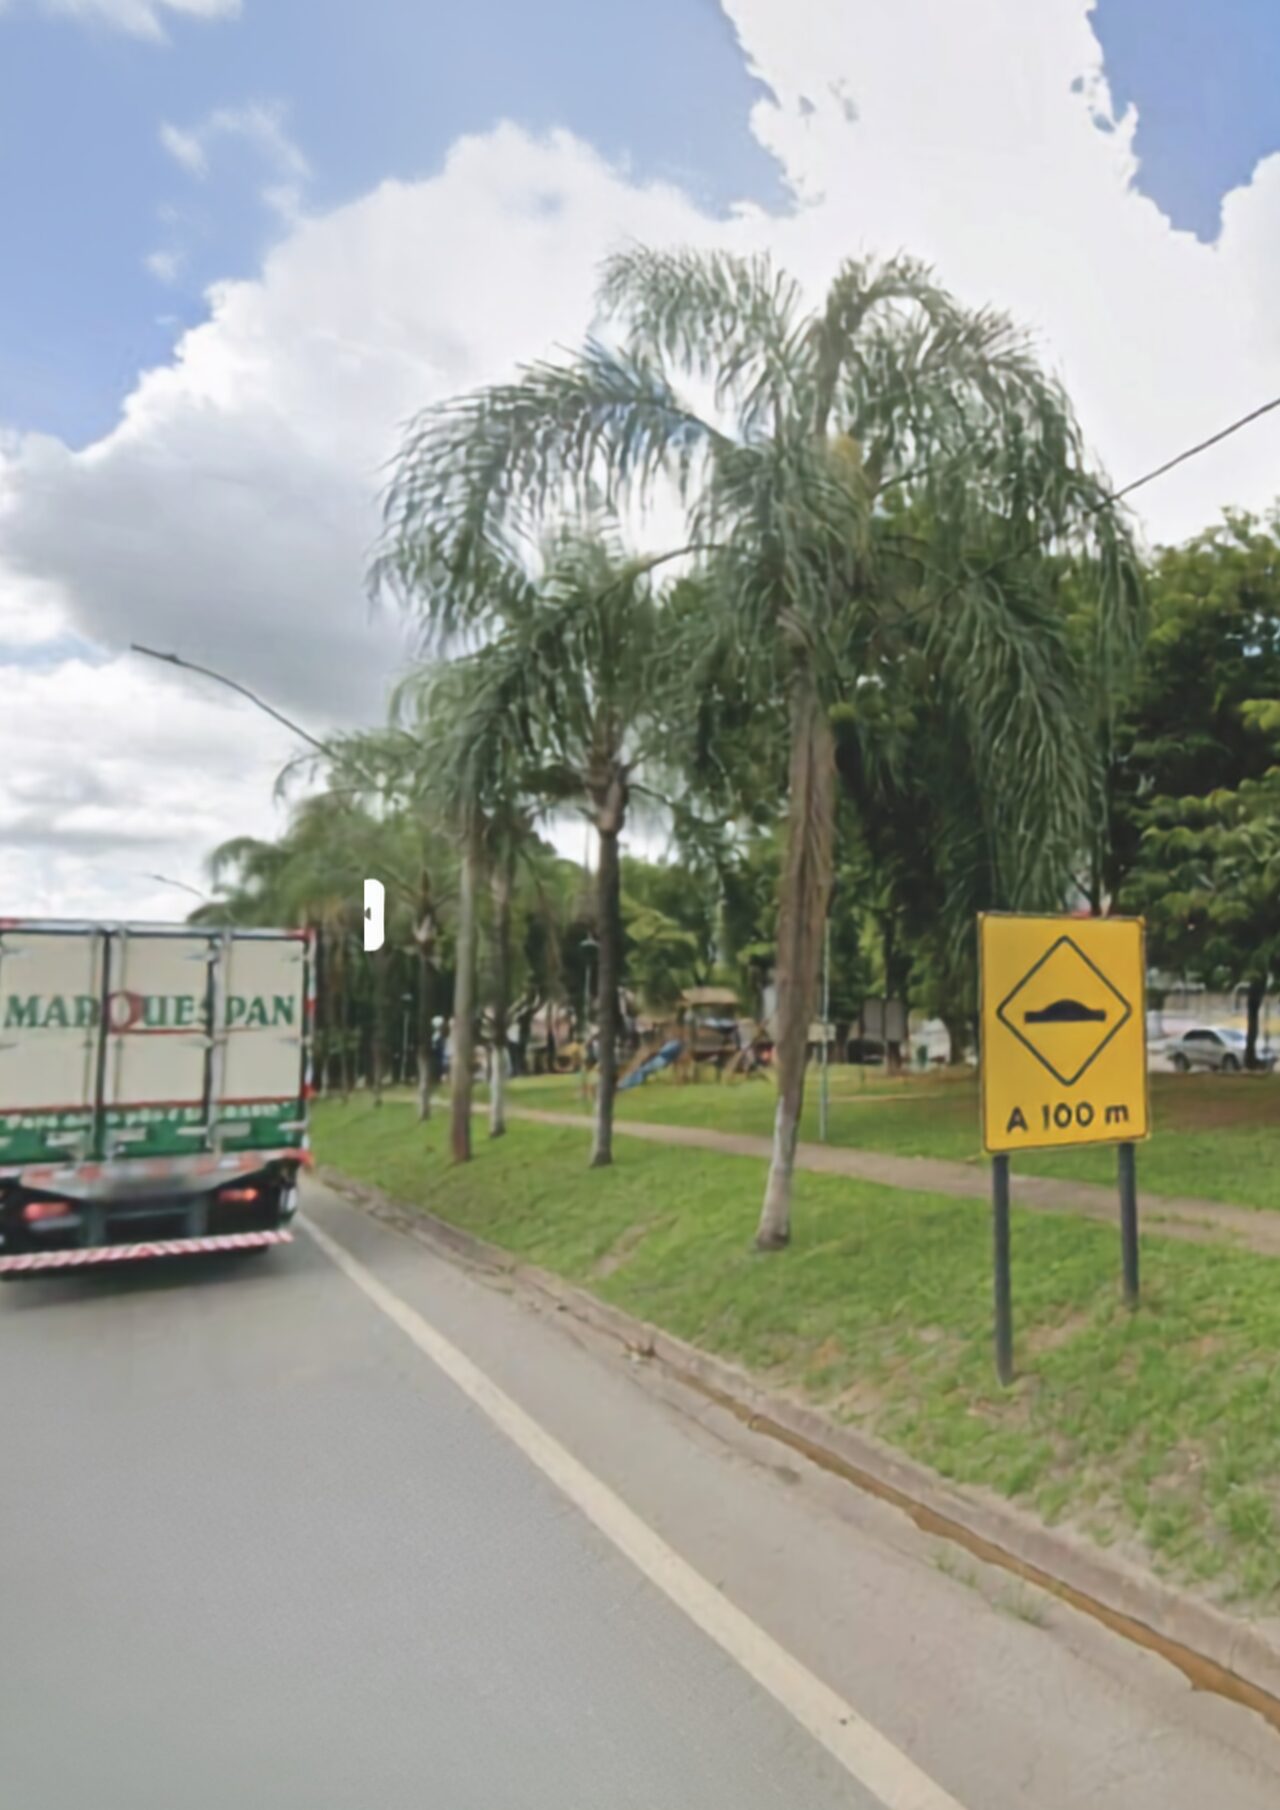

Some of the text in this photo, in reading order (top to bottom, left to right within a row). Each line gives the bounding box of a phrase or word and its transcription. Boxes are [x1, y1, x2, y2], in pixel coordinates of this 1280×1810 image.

[1006, 1101, 1129, 1134] A 100 m
